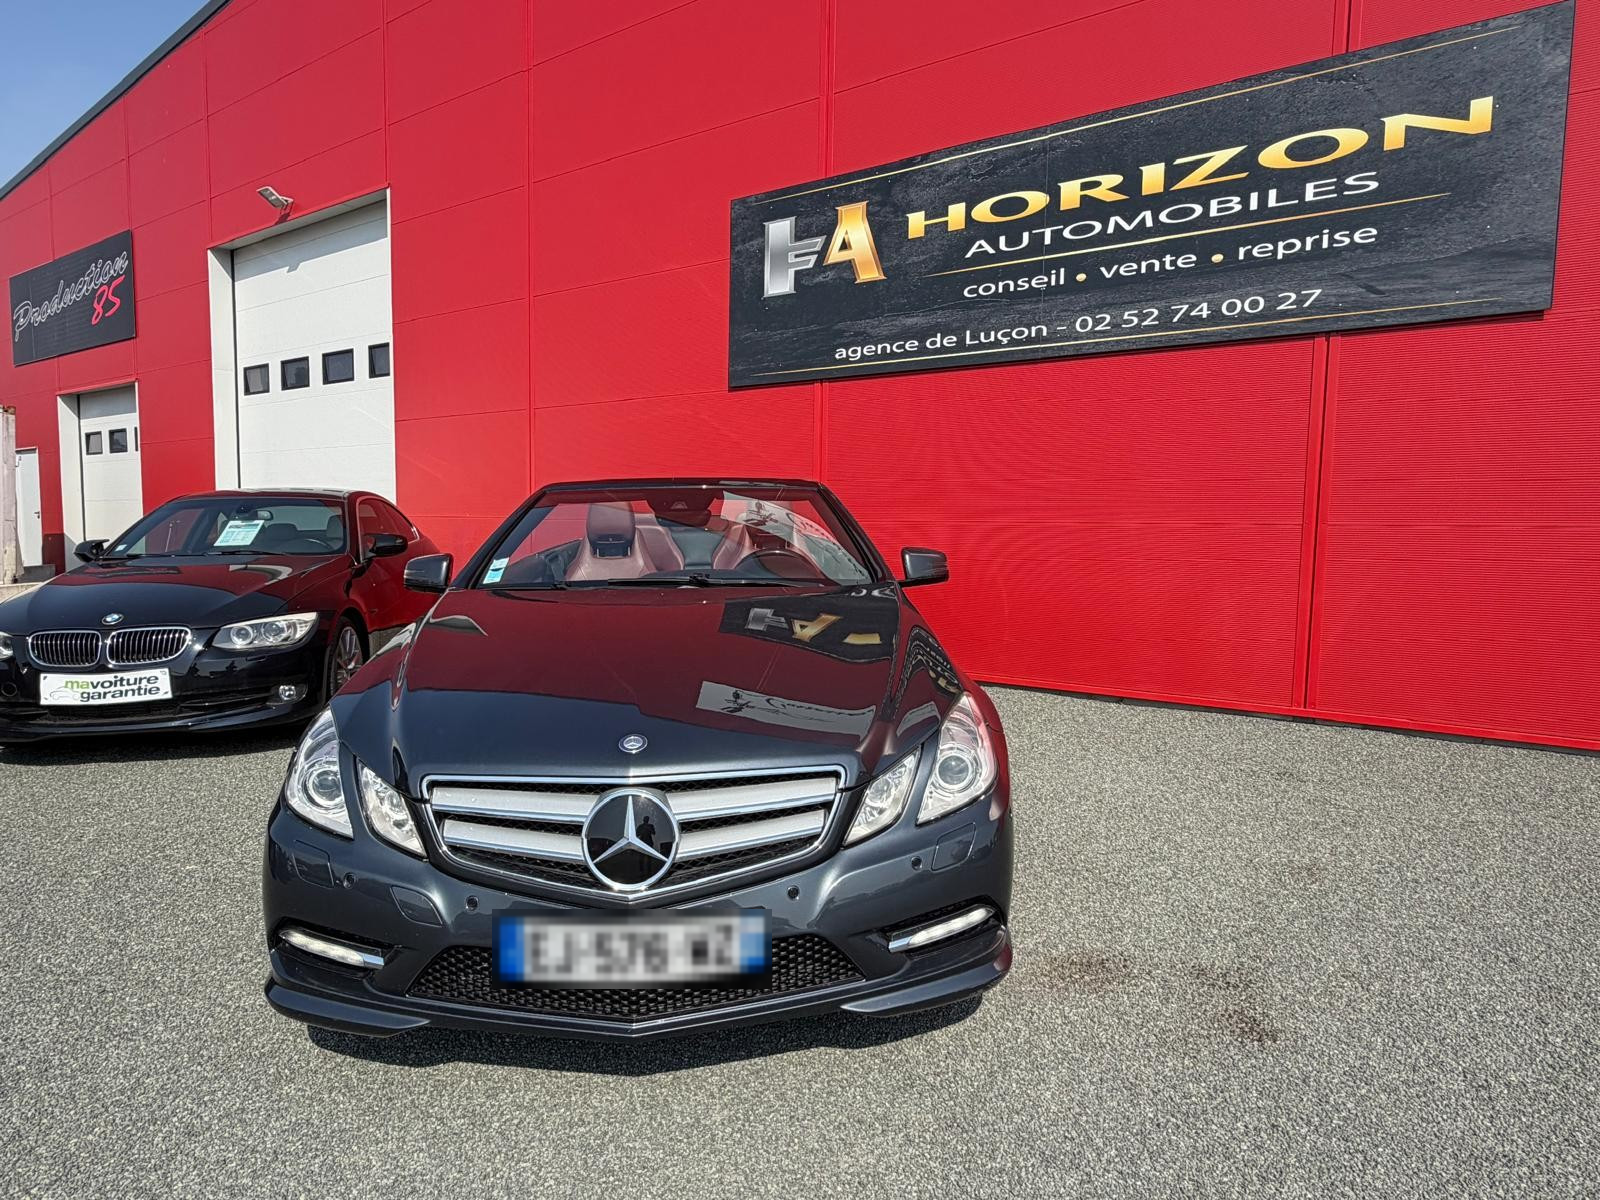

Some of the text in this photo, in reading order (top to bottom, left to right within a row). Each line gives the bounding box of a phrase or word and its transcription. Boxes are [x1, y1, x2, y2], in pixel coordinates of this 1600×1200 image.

[906, 96, 1495, 239] HORIZON
[965, 171, 1380, 259] AUTOMOBILES
[13, 251, 129, 342] Production
[963, 227, 1379, 298] conseil vente reprise
[91, 274, 126, 326] 85
[834, 334, 920, 361] agence
[925, 333, 957, 351] de
[965, 324, 1048, 348] Luçon
[1075, 313, 1114, 334] 02
[1120, 308, 1161, 329] 52
[1170, 303, 1211, 324] 74
[1220, 297, 1264, 317] 00
[1276, 289, 1323, 311] 27
[64, 675, 159, 689] mavoiture
[79, 684, 161, 702] garantie
